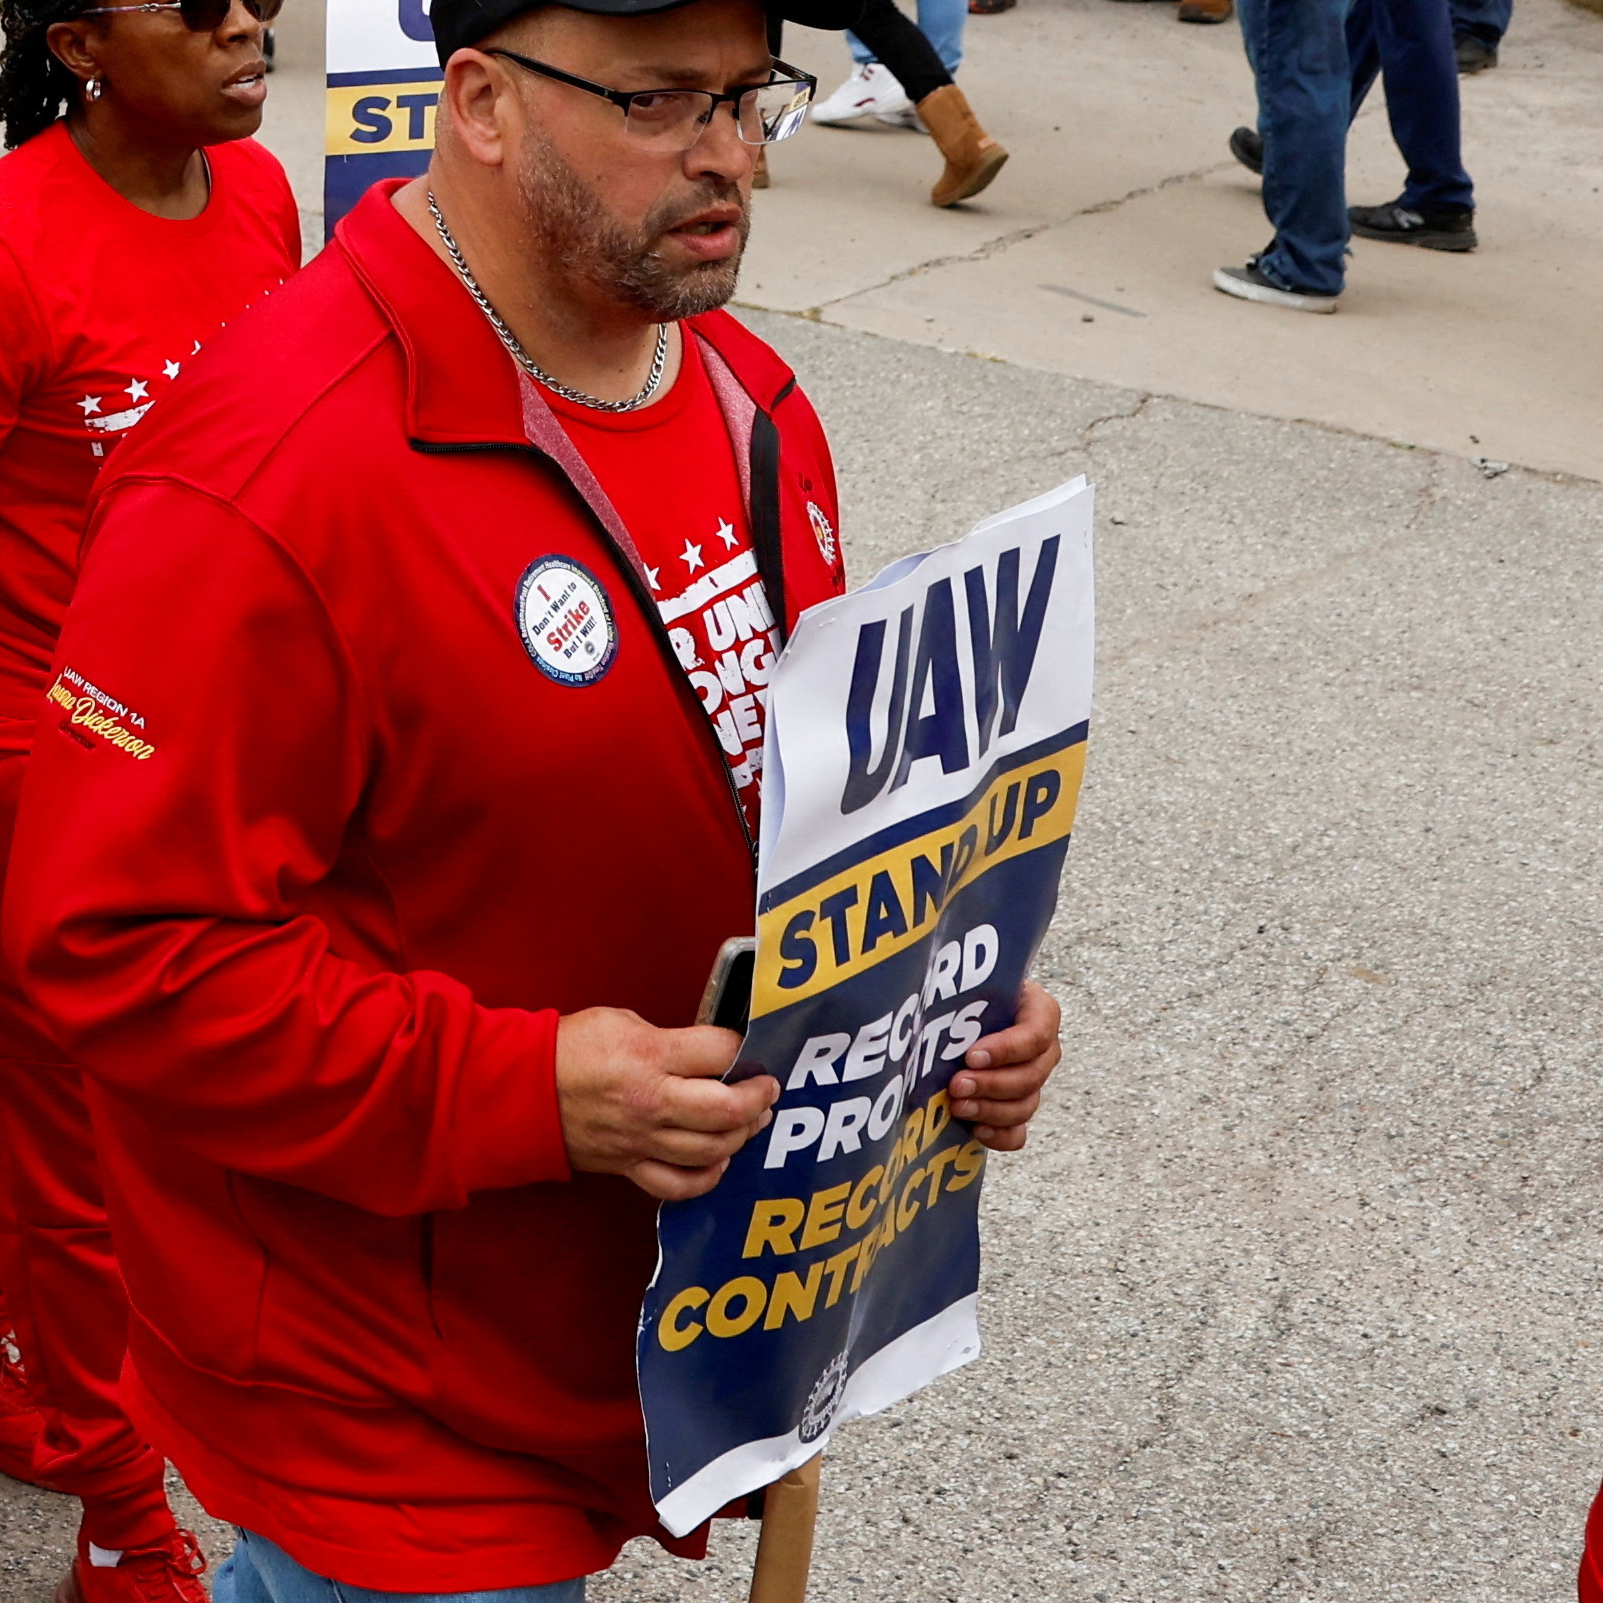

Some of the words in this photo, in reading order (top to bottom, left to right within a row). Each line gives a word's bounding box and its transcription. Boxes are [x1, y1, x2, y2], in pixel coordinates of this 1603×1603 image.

[532, 610, 554, 636] Don't
[550, 588, 572, 614] Want
[567, 582, 578, 594] to
[537, 584, 552, 602] I
[546, 600, 591, 652] Strike
[563, 642, 579, 659] But
[64, 666, 85, 687] UAW
[83, 682, 128, 717] REGION
[130, 713, 145, 729] 1A
[71, 697, 155, 760] Dickerson
[840, 535, 1061, 815] UAW
[775, 833, 975, 988] STAND
[987, 769, 1061, 855] UP
[786, 922, 998, 1092] RECORD
[764, 996, 983, 1170] PROFITS
[741, 1092, 950, 1259] RECORD
[656, 1138, 988, 1353] CONTRACTS
